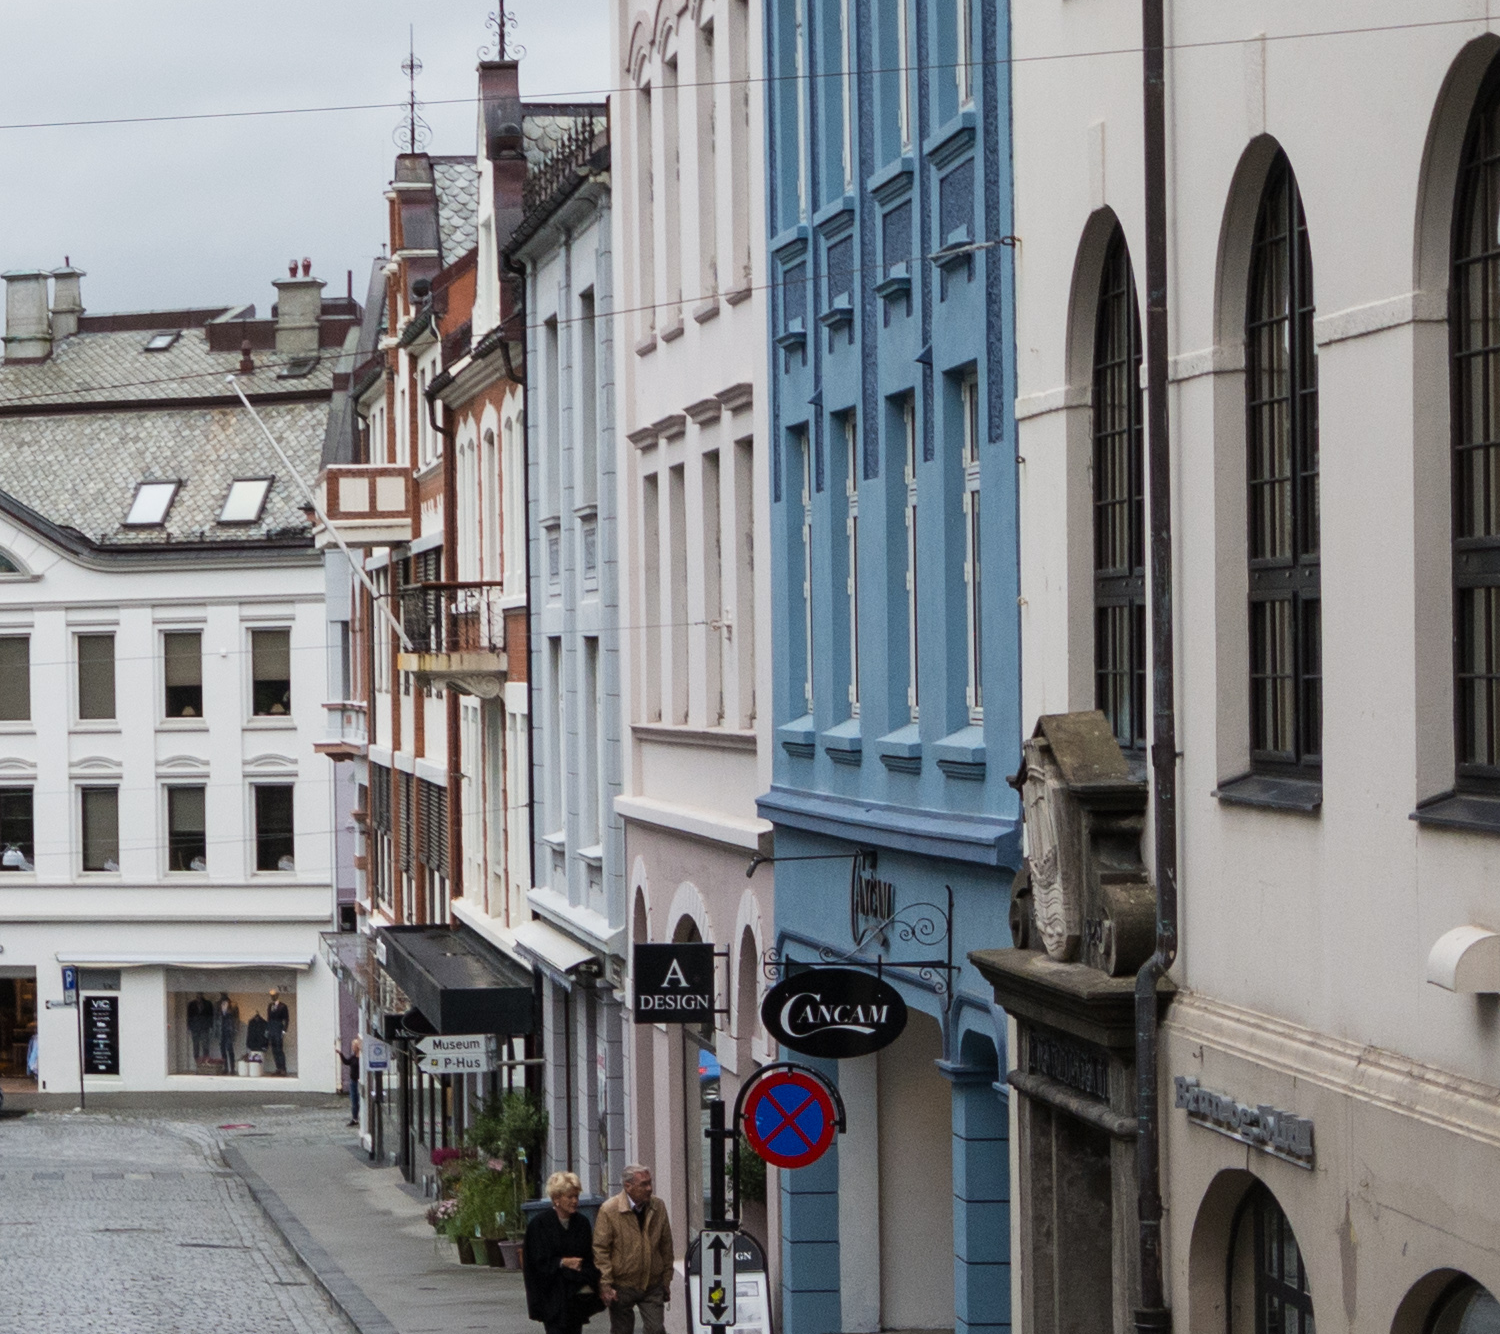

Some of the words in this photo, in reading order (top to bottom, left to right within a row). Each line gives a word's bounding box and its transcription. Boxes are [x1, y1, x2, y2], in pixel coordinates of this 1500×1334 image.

[661, 958, 690, 987] A
[639, 994, 710, 1010] DESIGN
[780, 992, 889, 1038] CANCAM
[432, 1038, 480, 1050] Museum
[444, 1057, 481, 1069] P-Hus
